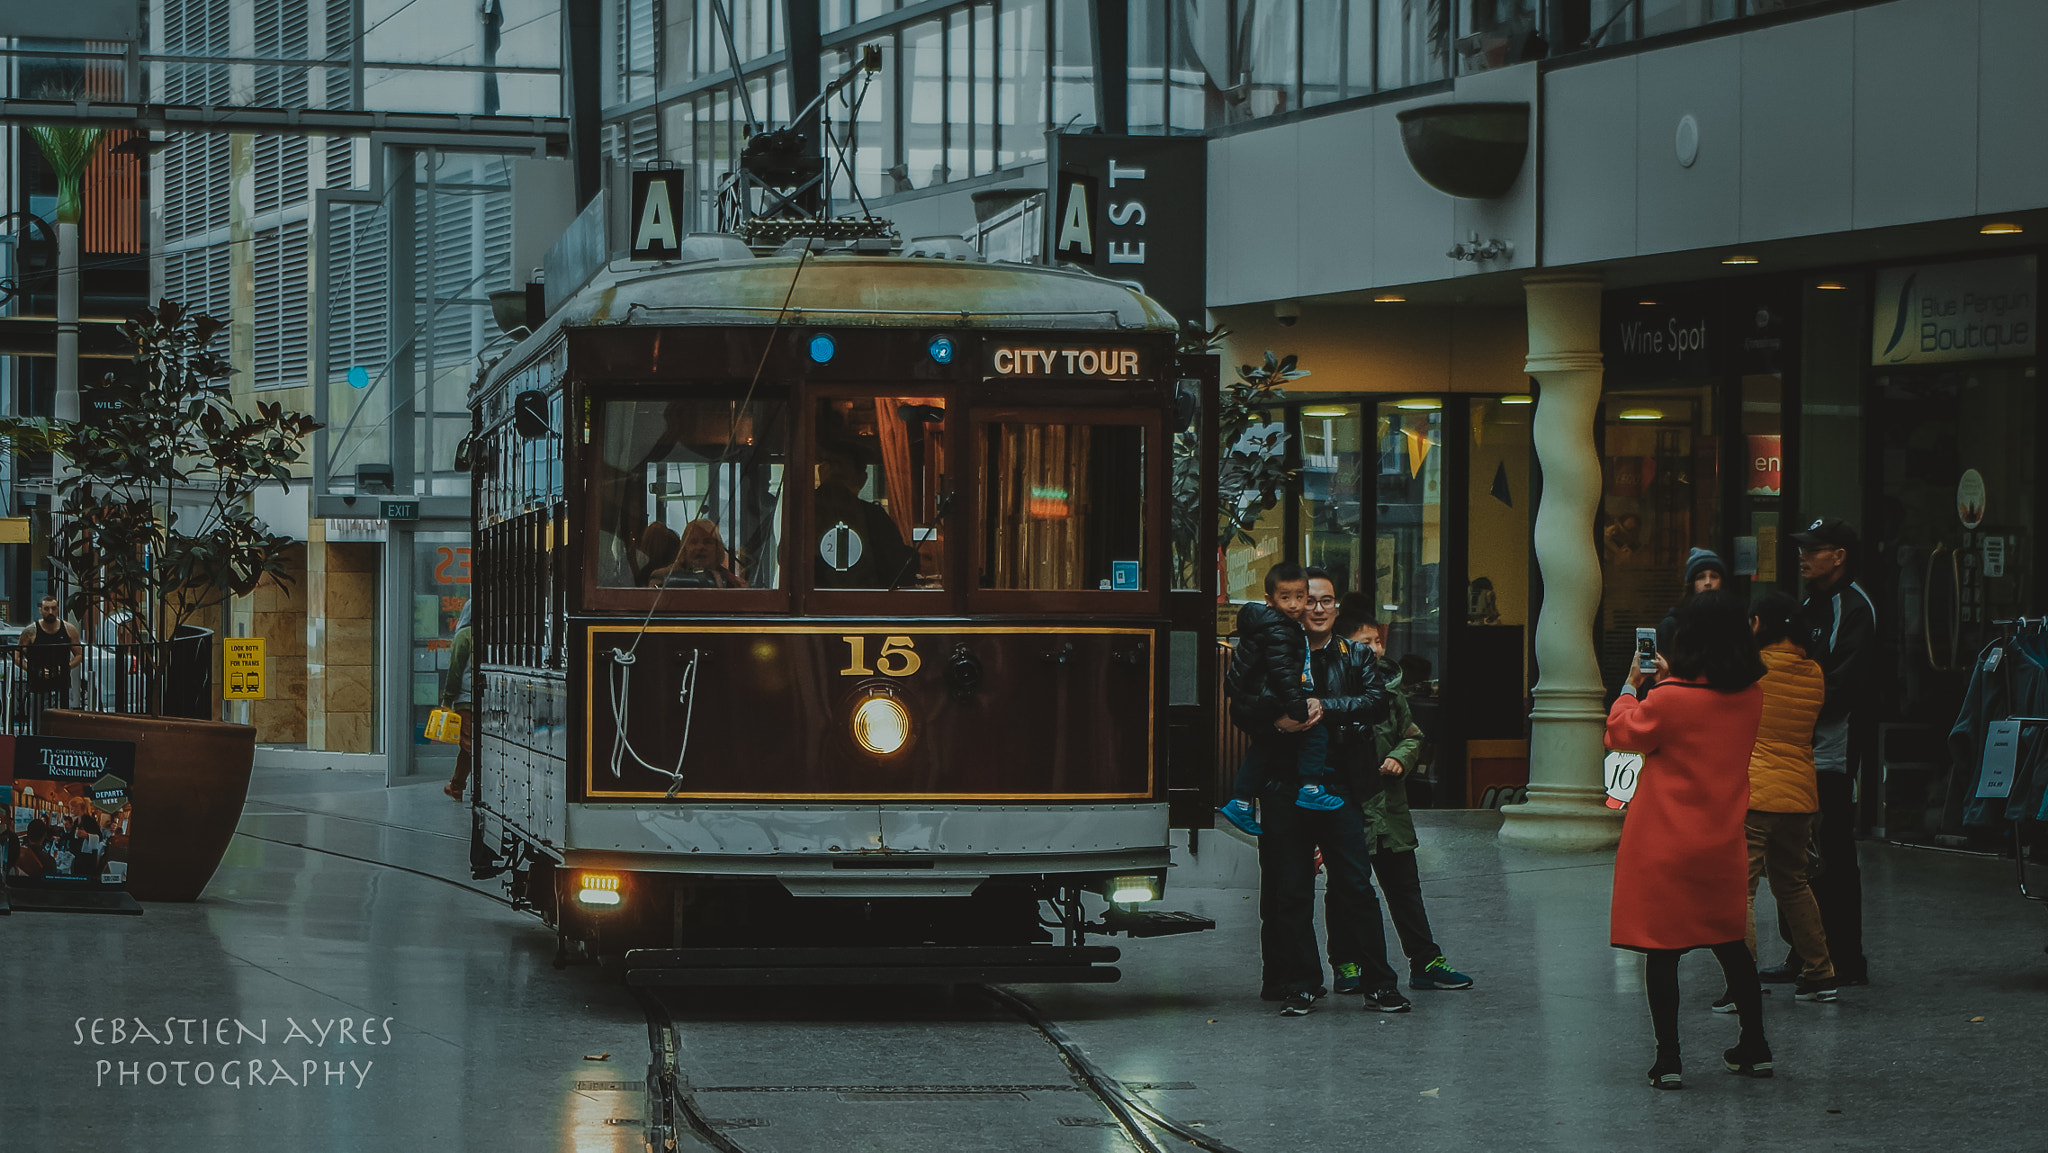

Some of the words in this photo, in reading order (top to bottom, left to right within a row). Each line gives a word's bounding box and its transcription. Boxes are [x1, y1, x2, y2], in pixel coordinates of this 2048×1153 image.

[635, 180, 676, 249] A
[1058, 183, 1092, 254] A
[1108, 159, 1147, 297] EST
[1921, 298, 1956, 318] Blue
[1963, 293, 2029, 316] Penguin
[1620, 321, 1662, 353] Wine
[1668, 317, 1706, 360] Spot
[1920, 318, 2029, 352] Boutique
[994, 350, 1056, 374] CITY
[1062, 350, 1139, 376] TOUR
[388, 505, 411, 517] EXIT
[840, 636, 921, 677] 15
[40, 748, 108, 772] Tramway
[49, 765, 98, 778] Restaurant
[1610, 759, 1635, 790] 16
[95, 789, 124, 799] DEPARTS
